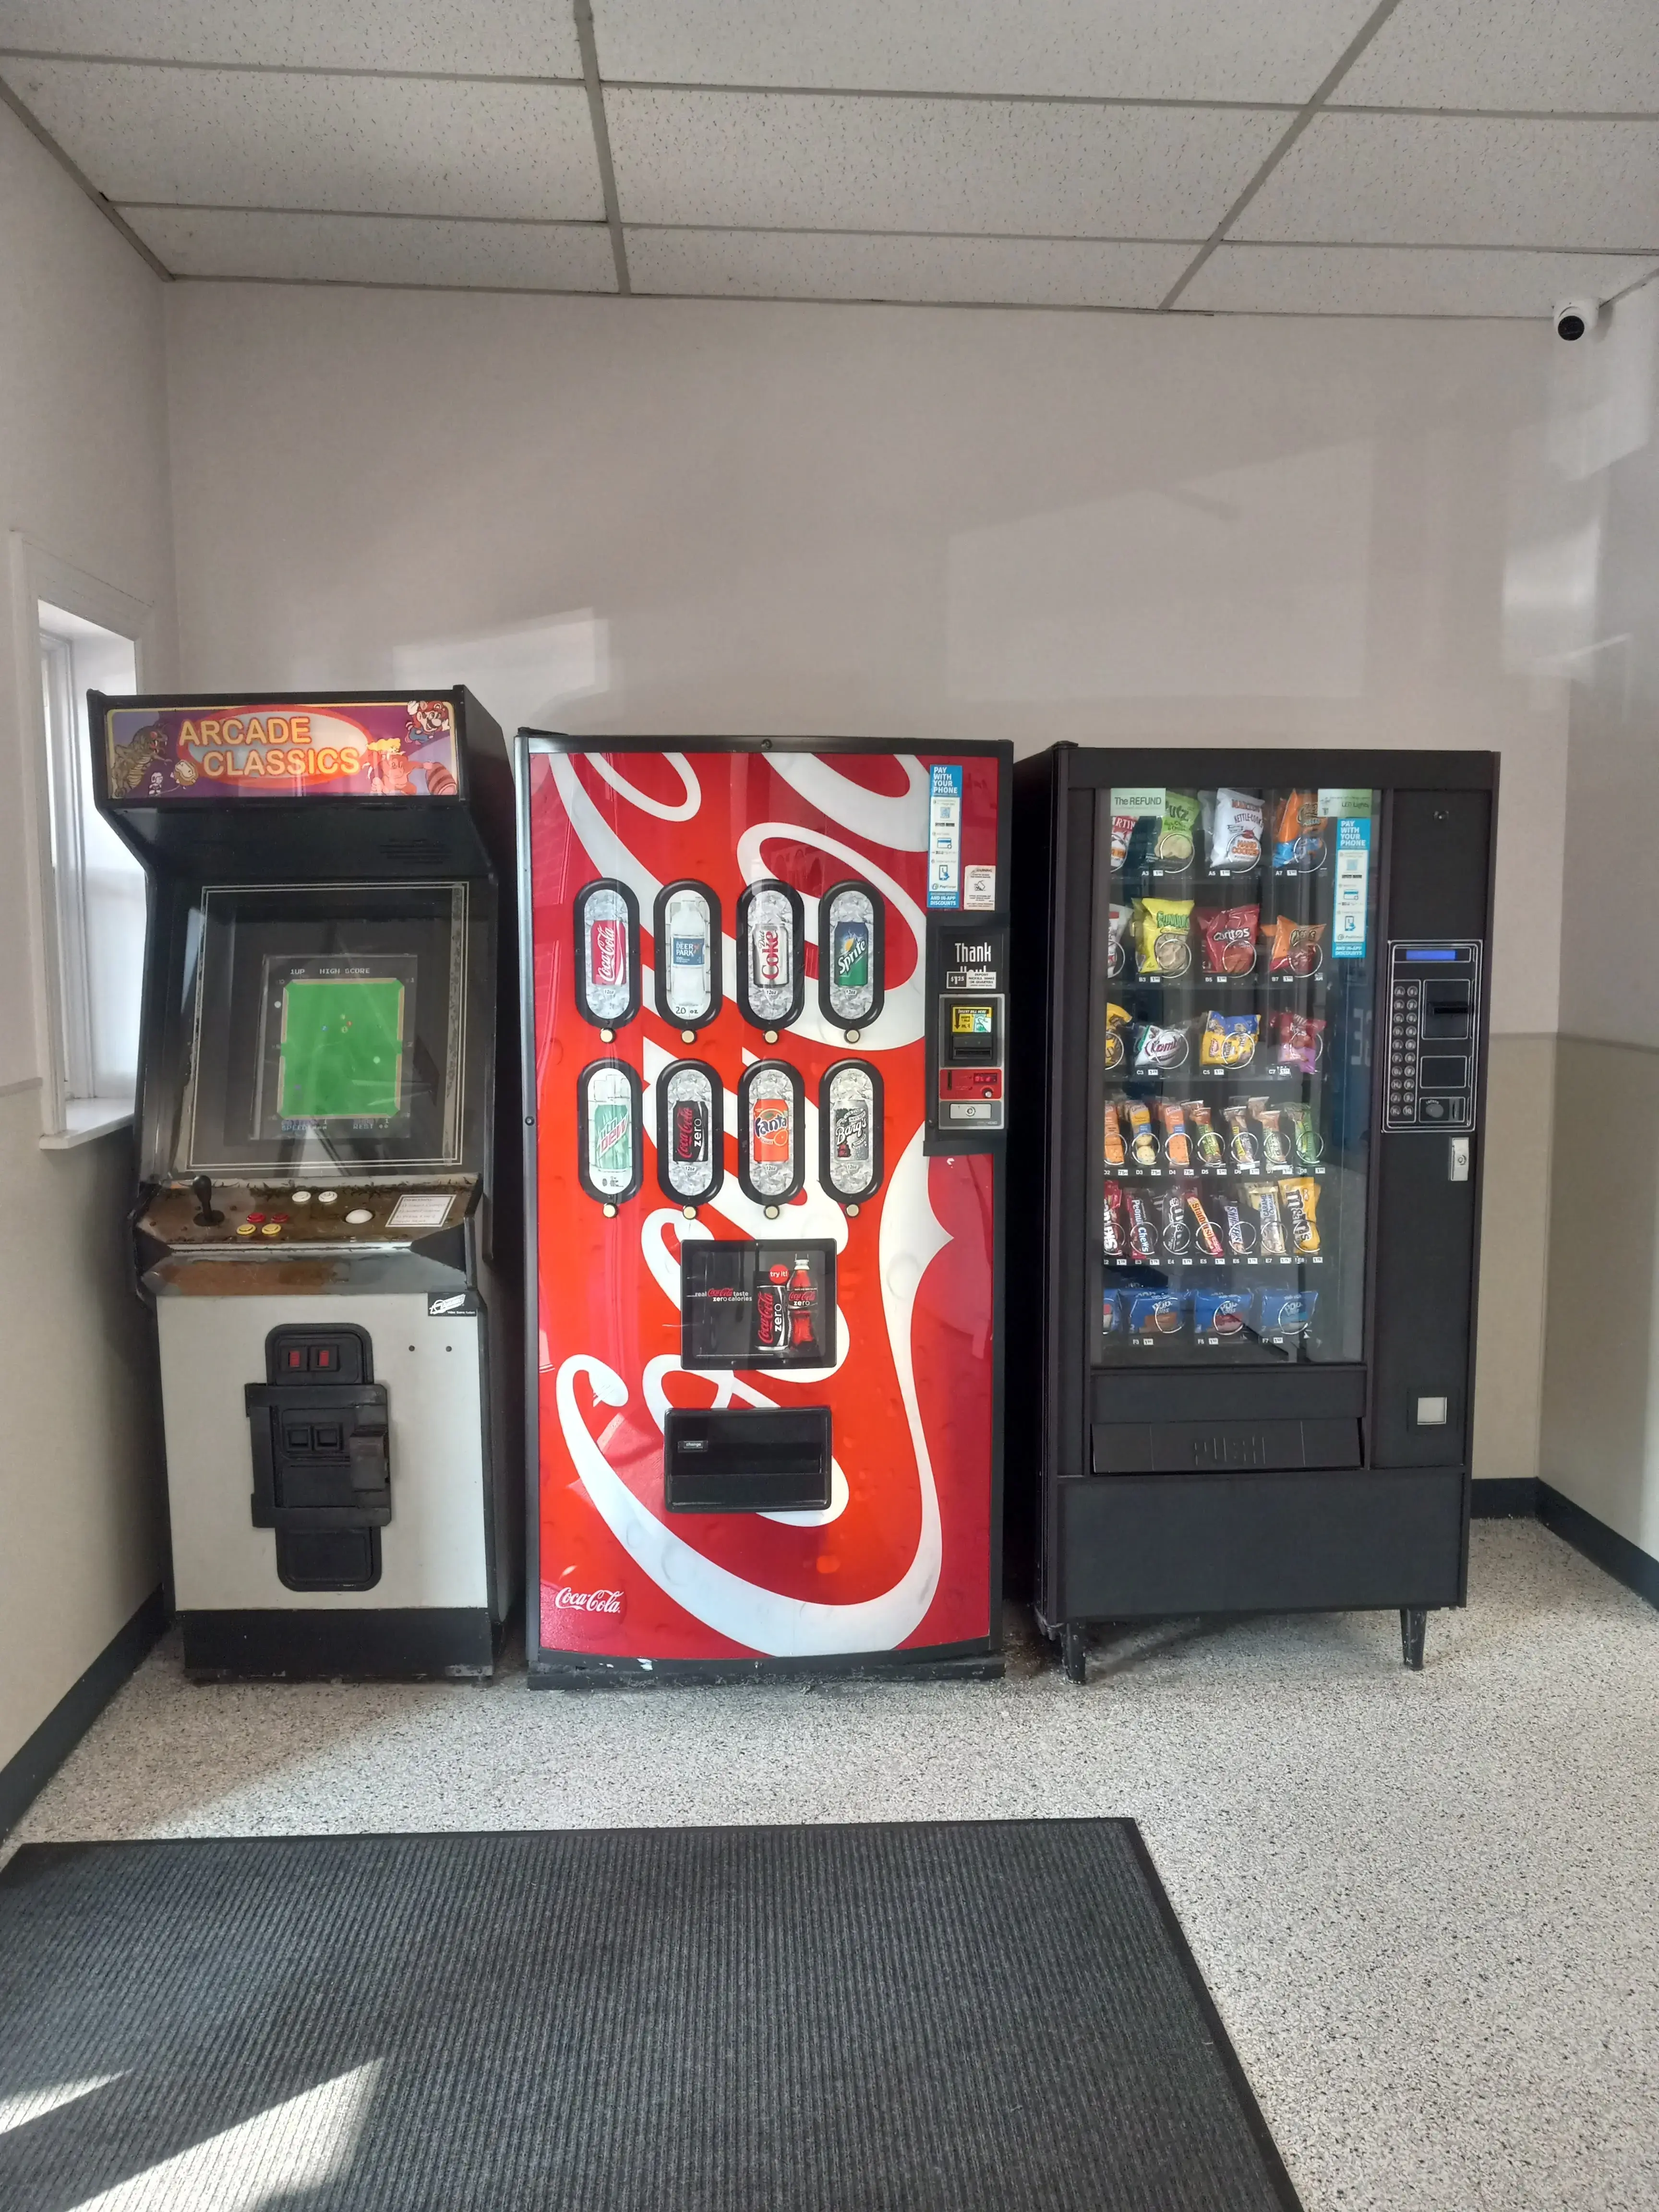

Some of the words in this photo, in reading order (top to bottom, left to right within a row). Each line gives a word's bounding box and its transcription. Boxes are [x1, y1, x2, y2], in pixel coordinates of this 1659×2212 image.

[179, 717, 312, 745] ARCADE
[203, 746, 361, 777] CLASSICS
[1114, 797, 1128, 805] The
[1129, 796, 1162, 805] REFUND
[761, 931, 779, 980] Coke
[838, 939, 866, 975] Sprite
[955, 942, 992, 963] Thank
[675, 1006, 686, 1014] 20
[694, 1118, 702, 1147] zero
[755, 1114, 787, 1137] Fanta
[835, 1118, 866, 1145] Barq's
[1131, 1199, 1143, 1226] Peanut
[758, 1291, 773, 1344] Coca-Cola
[774, 1303, 782, 1332] zero
[554, 1587, 624, 1613] Coca-Cola
